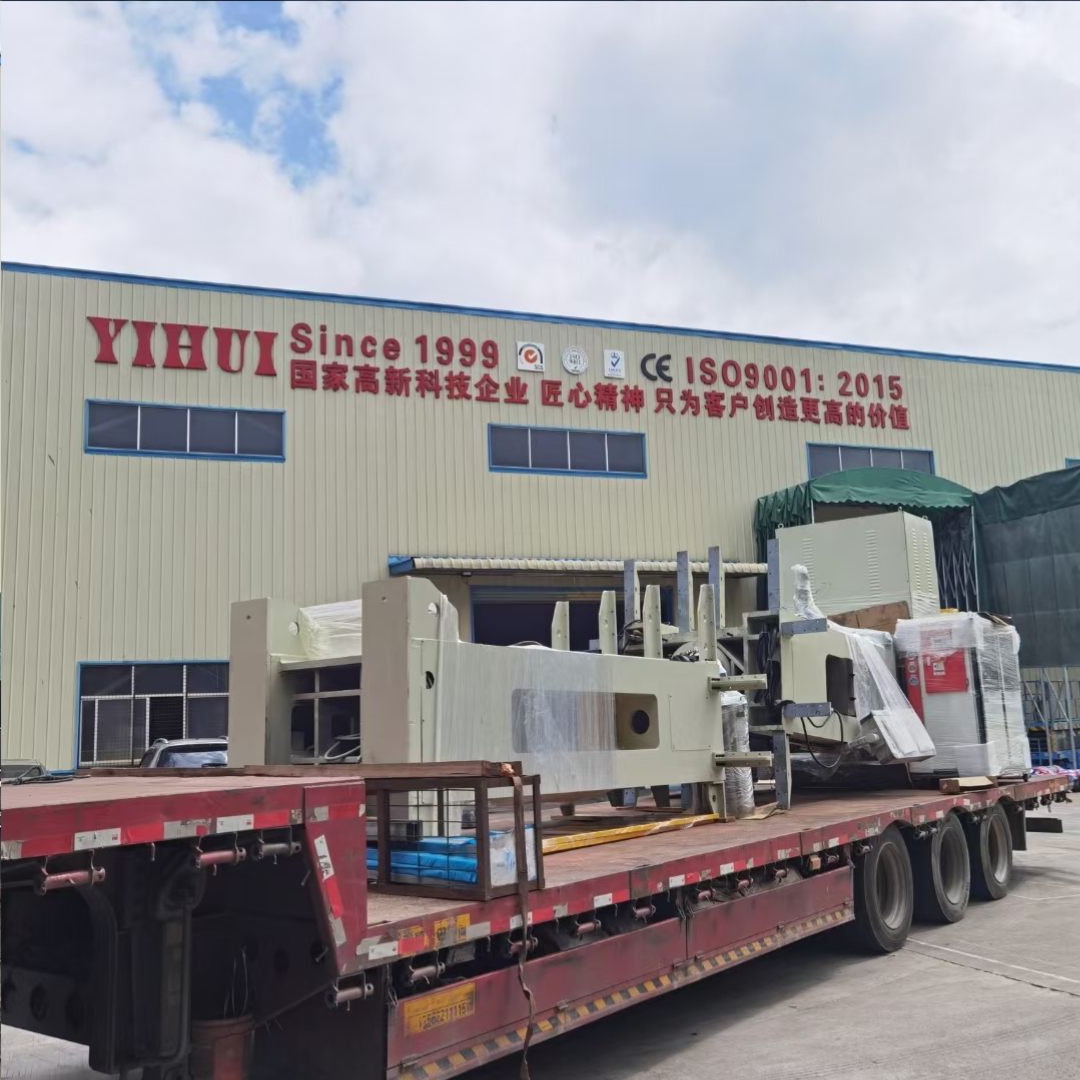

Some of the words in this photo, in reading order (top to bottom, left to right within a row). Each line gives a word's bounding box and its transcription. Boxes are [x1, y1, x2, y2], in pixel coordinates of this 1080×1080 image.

[87, 316, 278, 376] YIHUI
[290, 323, 401, 360] Since
[415, 335, 499, 369] 1999
[290, 359, 528, 404] 国家高新科技企业
[541, 379, 645, 412] 匠心精神
[655, 388, 910, 429] 只为客户创造更高的价值
[686, 357, 825, 394] ISO9001:
[838, 372, 902, 400] 2015
